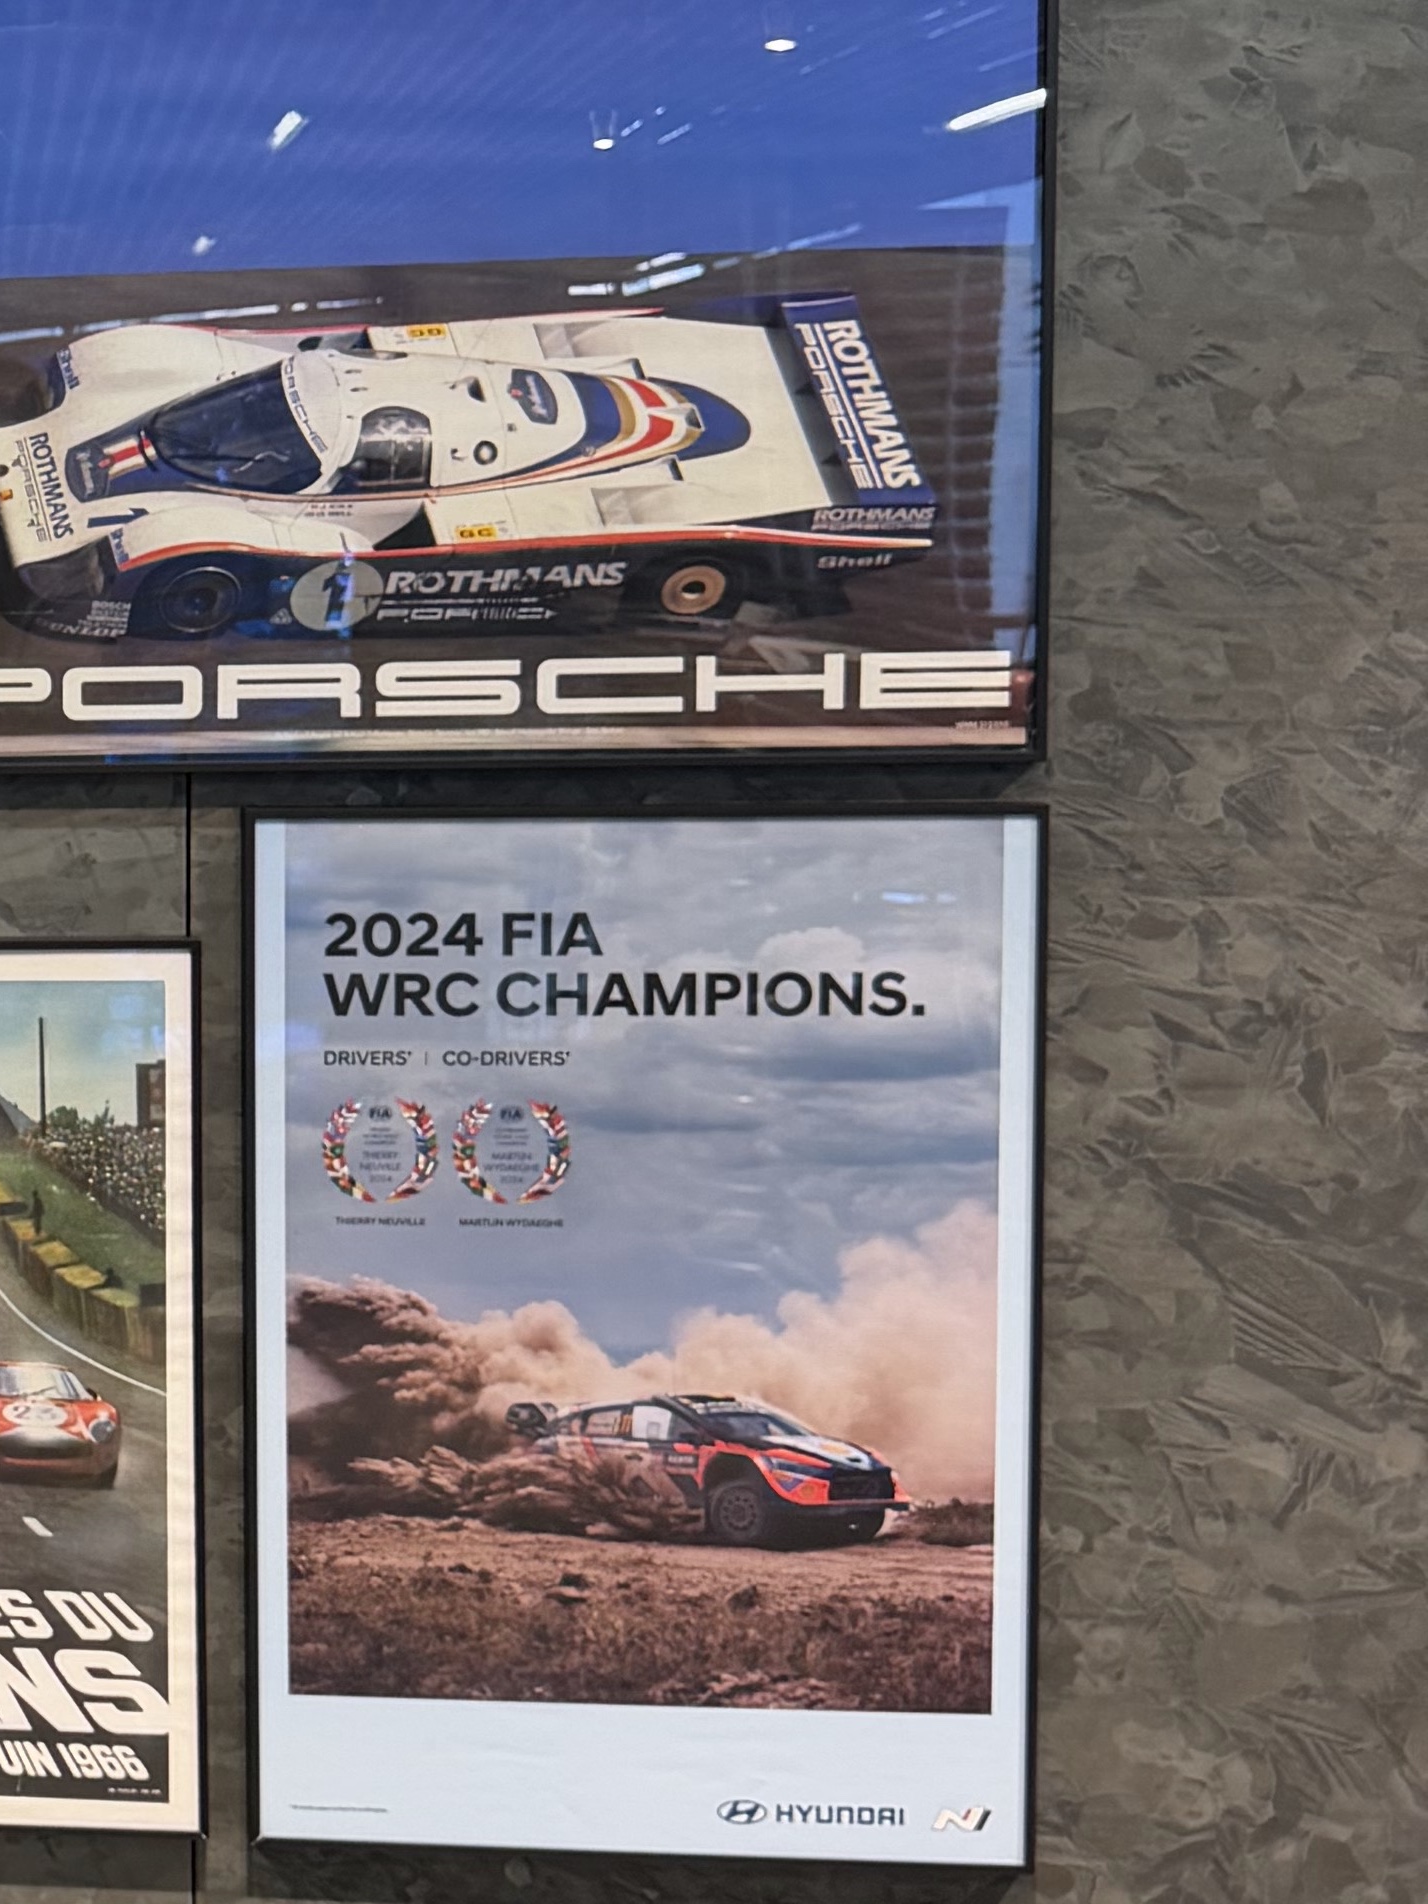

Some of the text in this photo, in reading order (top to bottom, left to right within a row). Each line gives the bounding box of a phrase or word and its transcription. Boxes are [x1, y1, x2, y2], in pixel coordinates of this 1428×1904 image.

[794, 322, 874, 490] PORSCHE
[825, 320, 921, 490] ROTHMANS
[29, 431, 76, 540] ROTHMANS
[814, 506, 937, 524] ROTHMANS
[384, 561, 627, 595] ROTHMANS
[817, 552, 892, 570] Shell
[323, 912, 604, 957] 2024 FIA
[322, 971, 927, 1018] WRC CHAMPIONS.
[323, 1049, 571, 1067] DRIVERS' CO-DRIVERS'
[378, 1216, 426, 1227] NEUVILLE
[44, 1589, 154, 1642] DU
[55, 1743, 150, 1781] 1966
[775, 1803, 905, 1826] HYUNDAI
